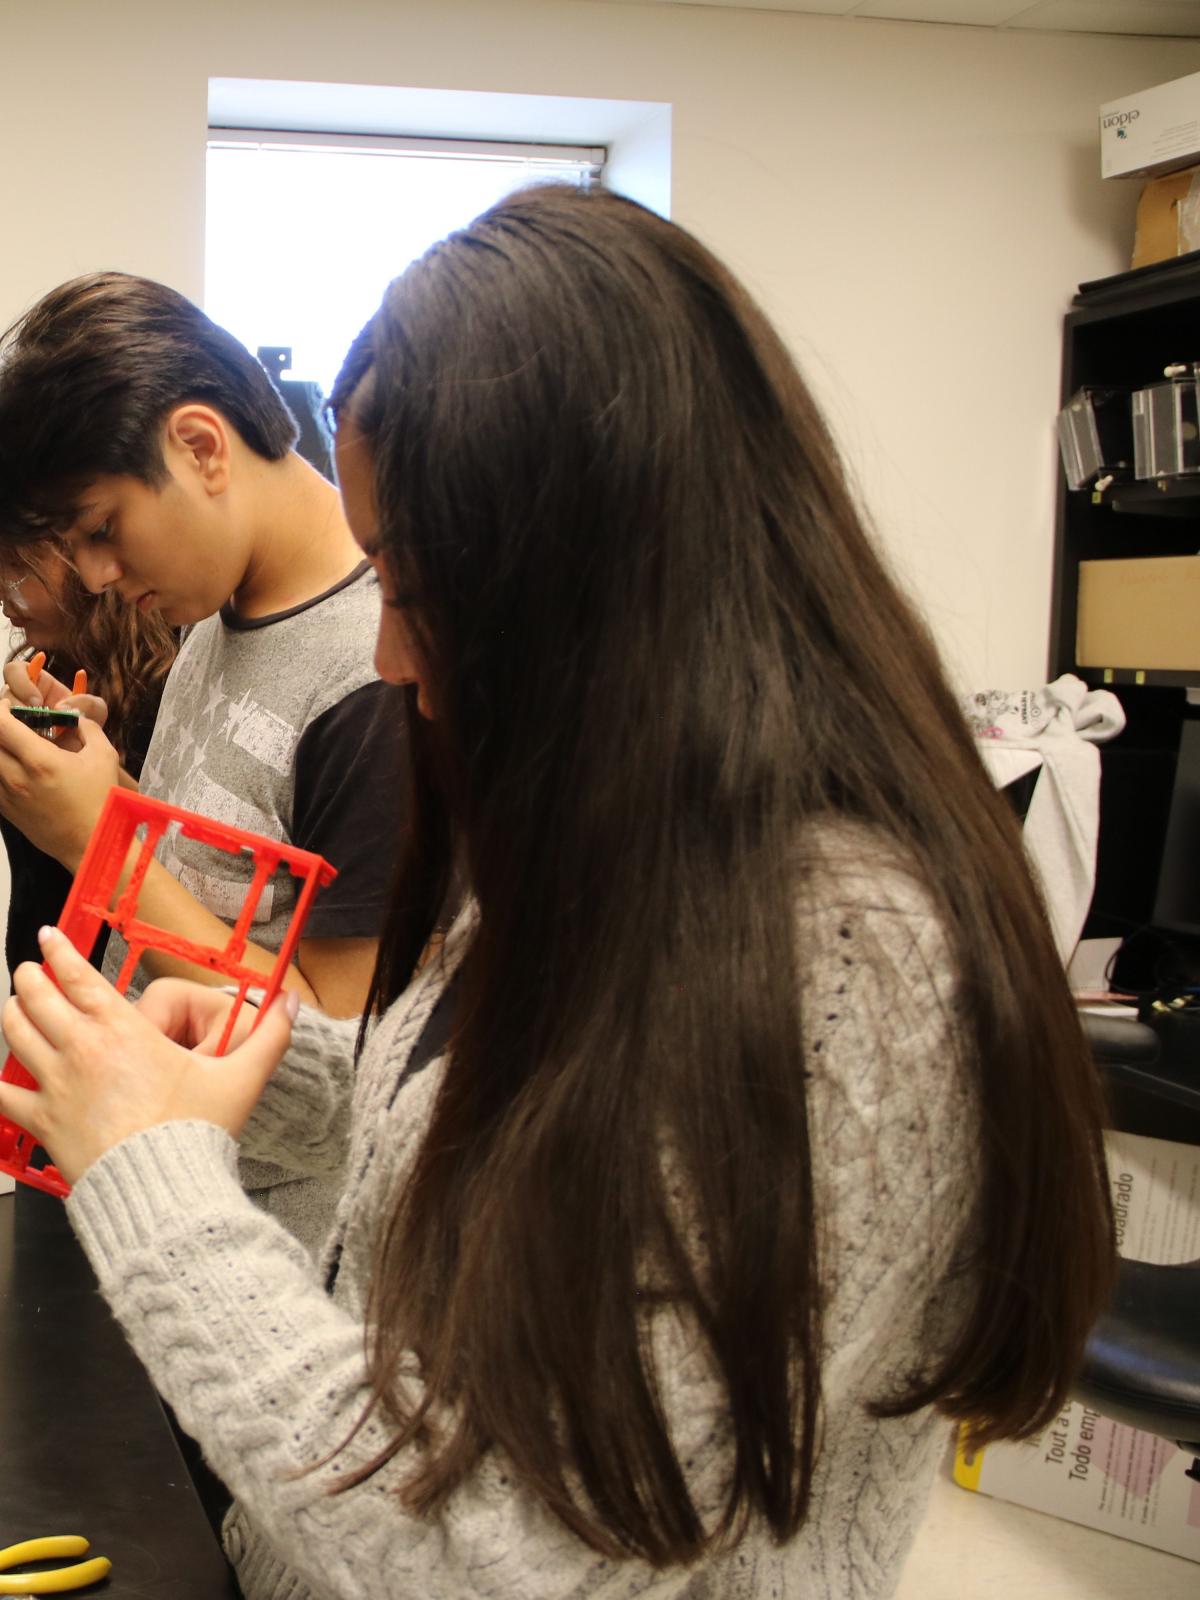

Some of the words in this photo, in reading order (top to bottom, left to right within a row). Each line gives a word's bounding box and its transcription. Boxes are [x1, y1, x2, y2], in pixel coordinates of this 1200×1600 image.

[1103, 109, 1140, 128] eldon
[1044, 1429, 1067, 1464] Tout
[1069, 1444, 1092, 1480] Todo
